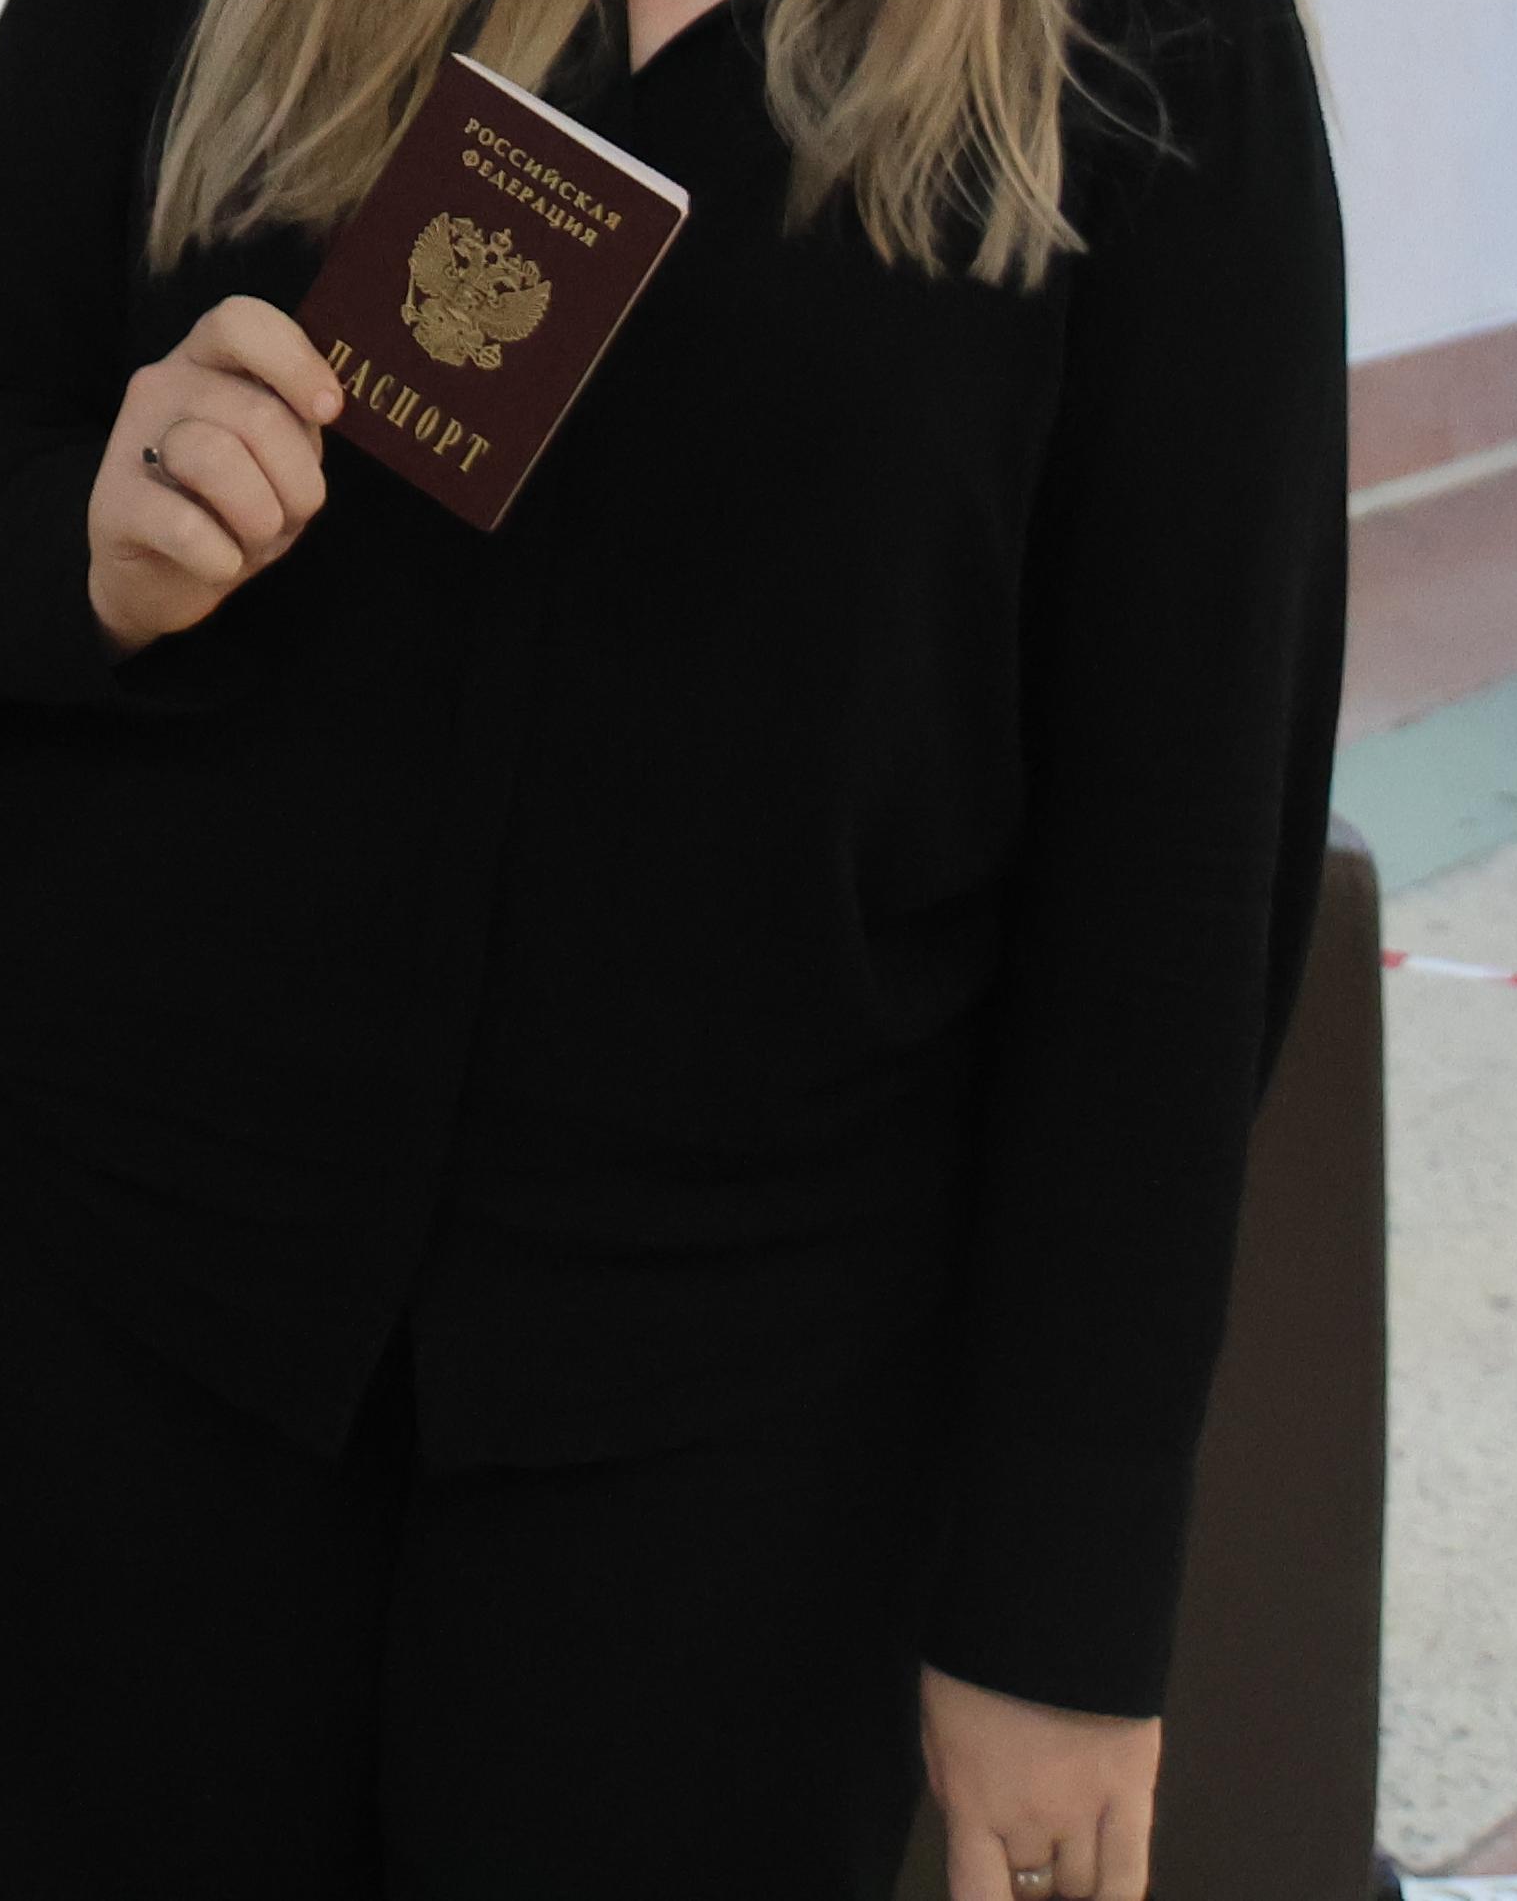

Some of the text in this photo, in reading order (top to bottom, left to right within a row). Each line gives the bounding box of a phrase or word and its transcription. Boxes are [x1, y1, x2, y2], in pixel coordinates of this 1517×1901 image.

[461, 148, 598, 248] ФЕДЕРАЦИЯ
[463, 116, 623, 232] РОССИЙСКАЯ
[325, 339, 491, 474] ПАСПОРТ
